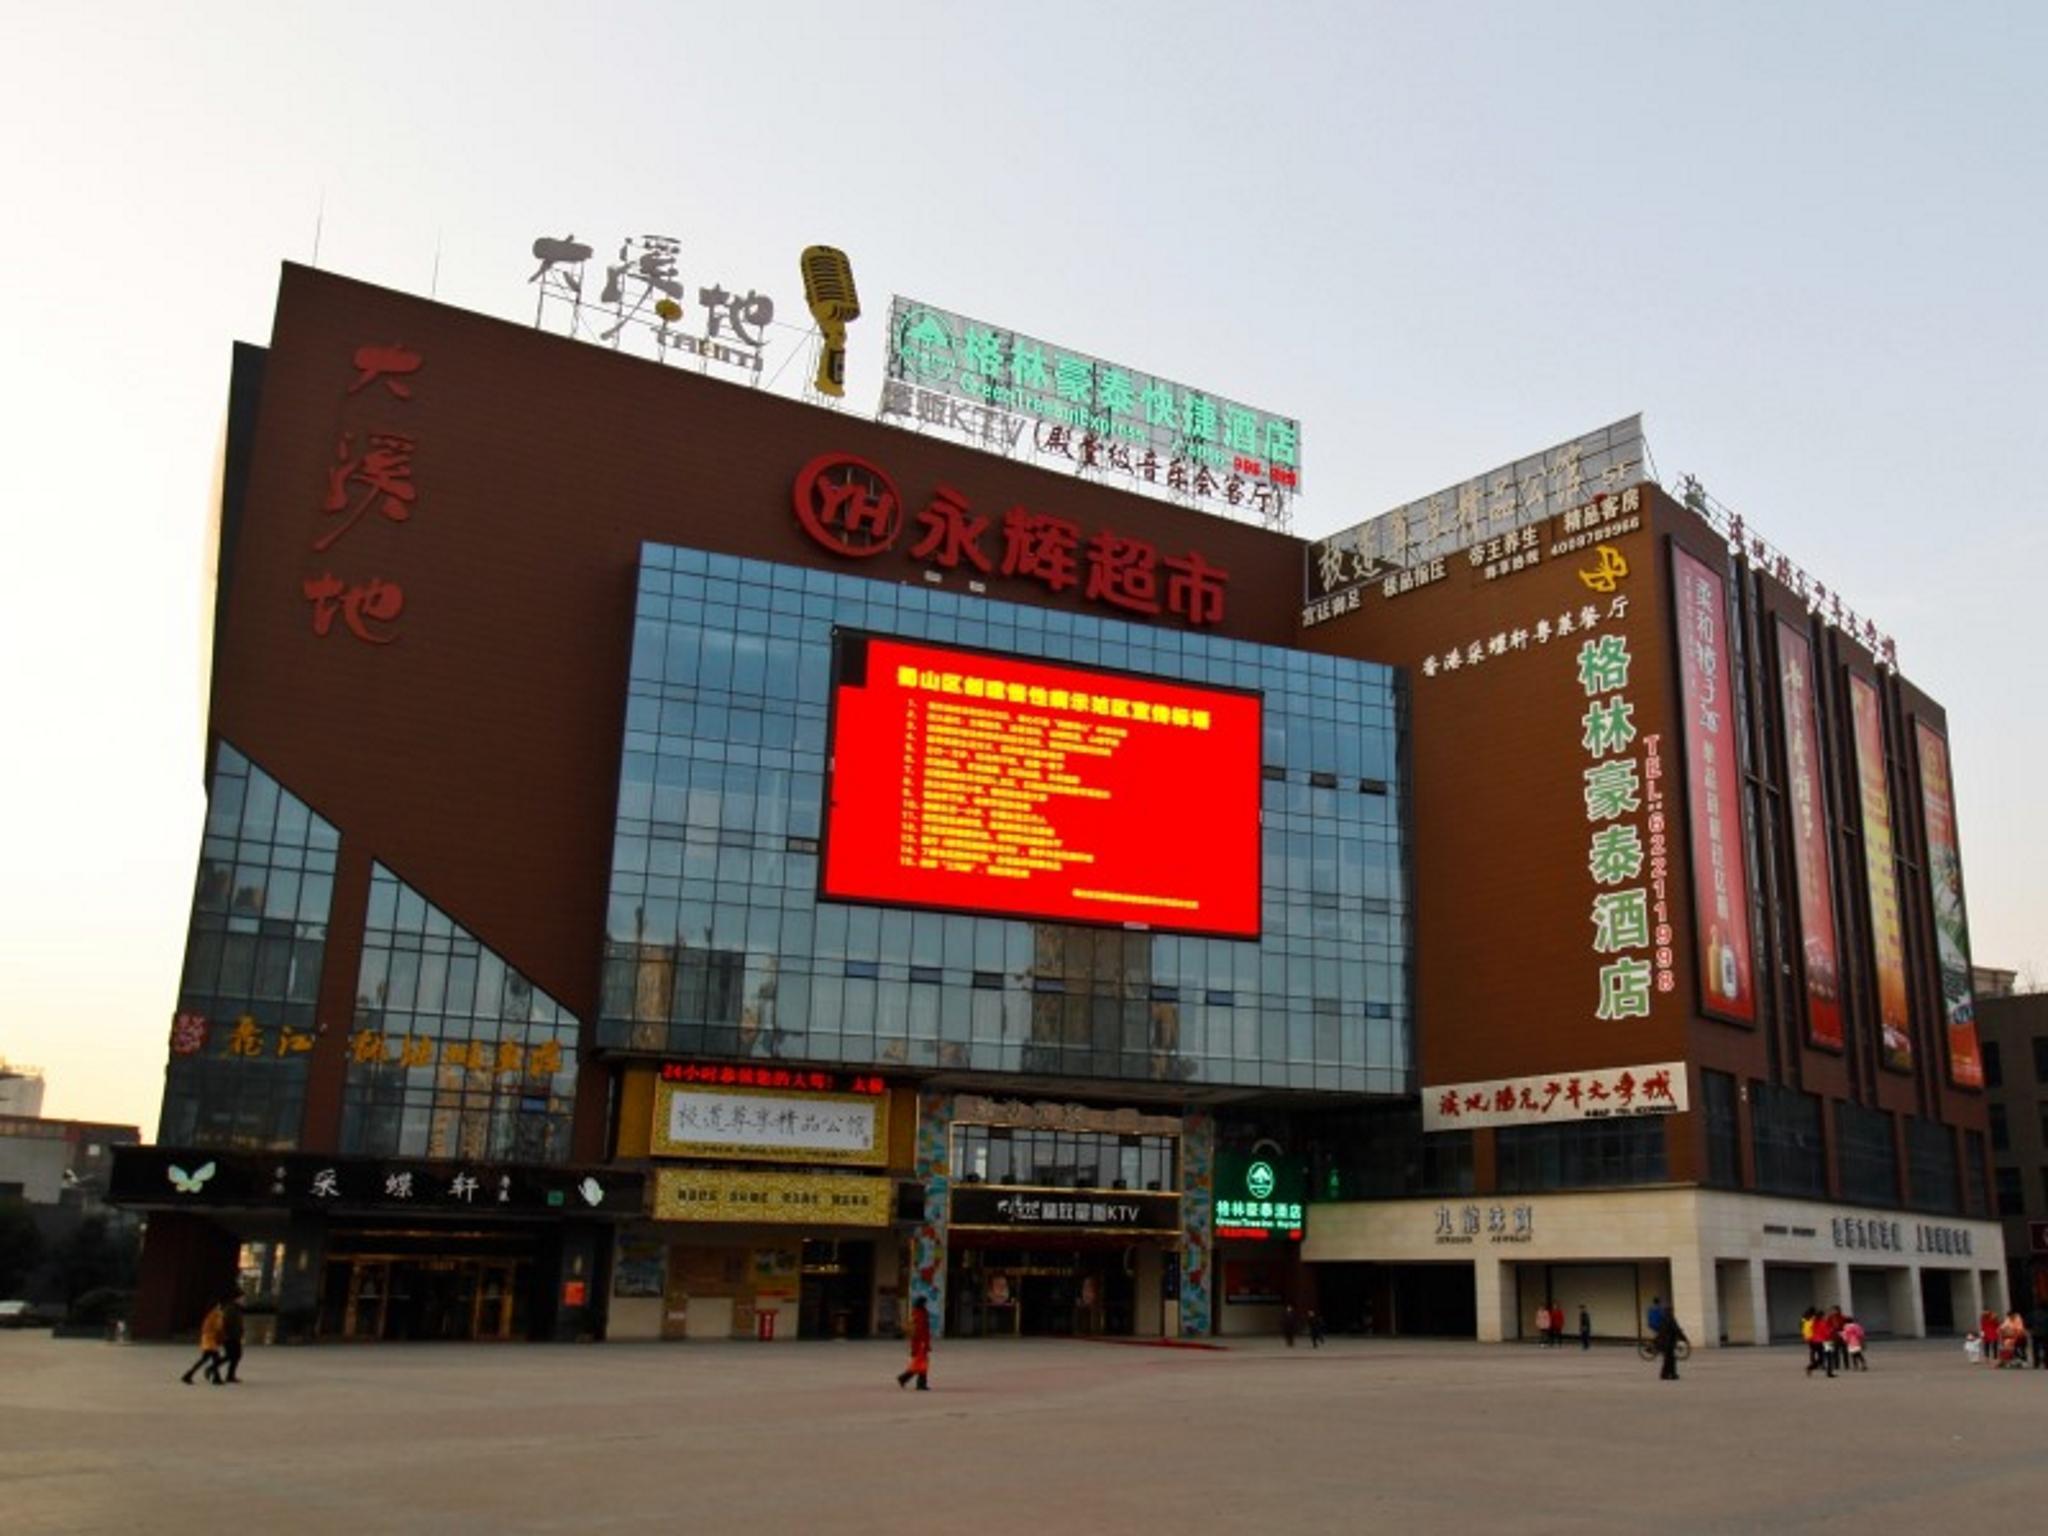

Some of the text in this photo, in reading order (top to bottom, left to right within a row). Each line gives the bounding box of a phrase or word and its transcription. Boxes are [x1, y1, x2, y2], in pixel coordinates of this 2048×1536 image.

[527, 233, 774, 346] 大溪地
[964, 326, 1297, 467] 格林豪泰快捷酒店
[304, 344, 422, 643] 大溪地
[912, 484, 1230, 623] 永辉超市
[1576, 634, 1651, 1021] 格林豪泰酒店
